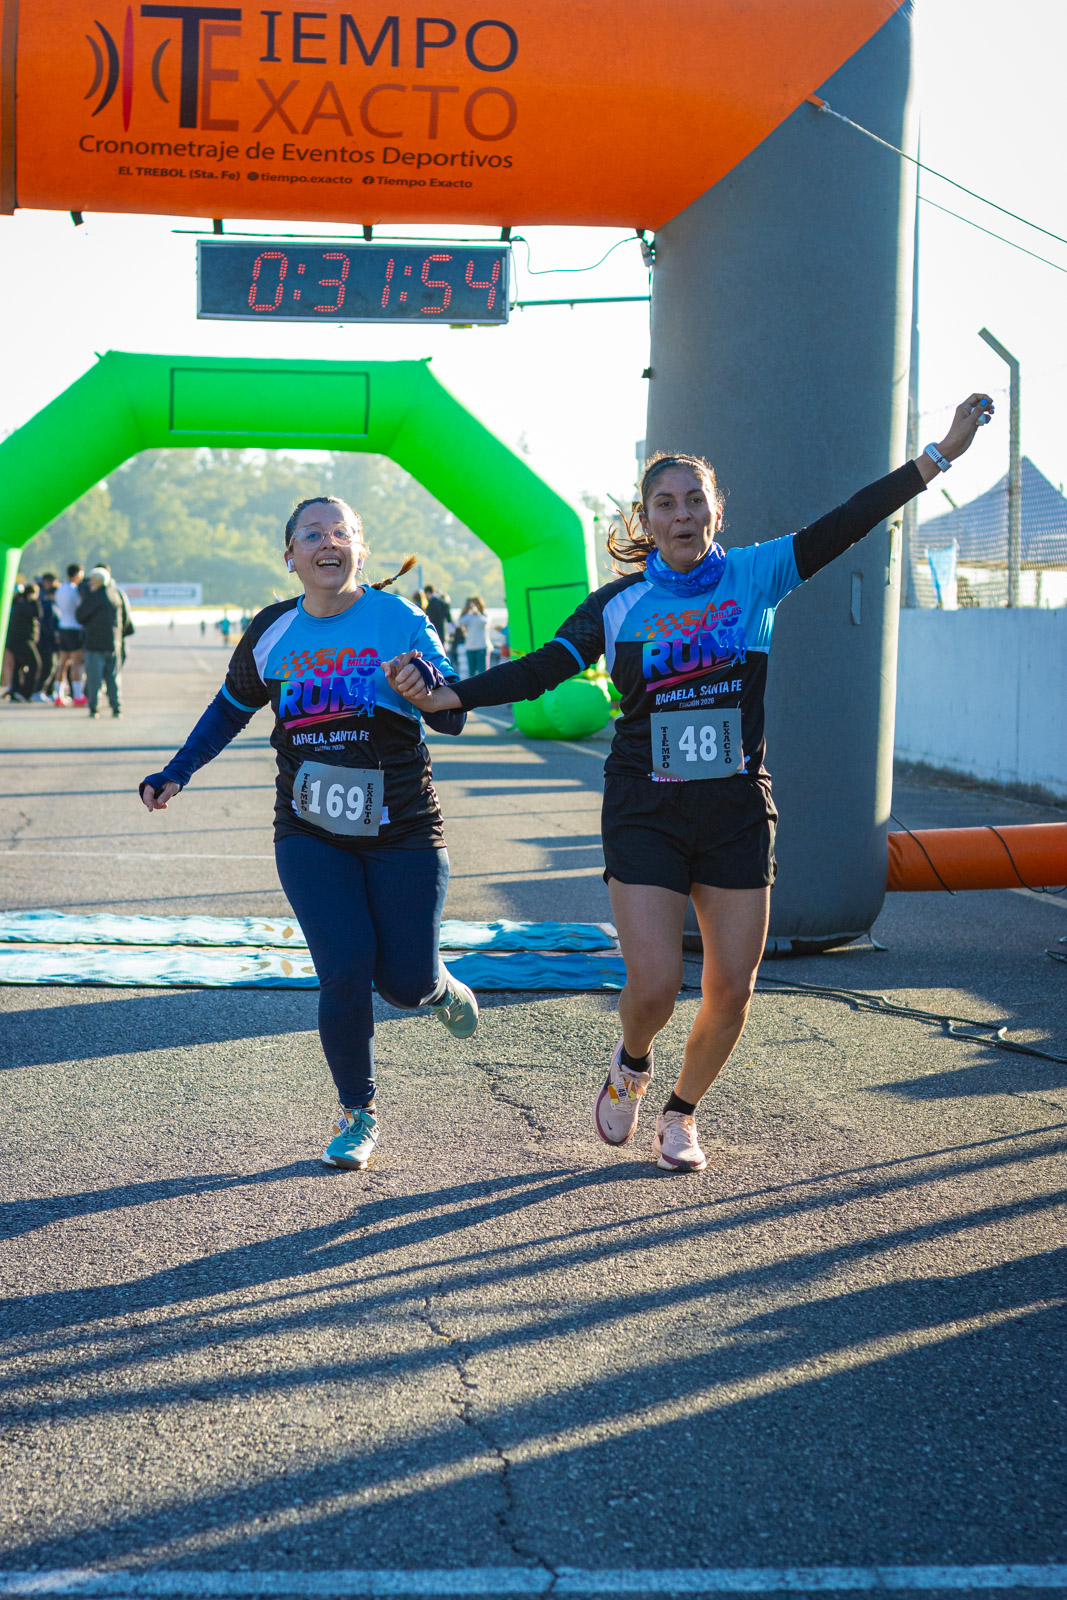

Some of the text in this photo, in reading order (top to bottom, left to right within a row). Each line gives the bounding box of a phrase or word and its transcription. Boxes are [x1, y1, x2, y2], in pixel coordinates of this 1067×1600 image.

[78, 134, 513, 169] Cronometraje de Eventos Deportivos
[118, 166, 240, 181] EL TREBOL (Sta. Fe)
[261, 173, 353, 185] tiempo.exacto
[377, 176, 473, 188] Tiempo Exacto
[247, 251, 501, 314] 0:31:54
[711, 607, 742, 621] MILLAS
[348, 658, 381, 667] MILLAS
[642, 629, 733, 679] RUN
[279, 677, 362, 718] RUN
[655, 679, 742, 706] RAFAELA, SANTA FE
[329, 730, 357, 743] SANTA
[359, 729, 369, 742] FE
[660, 726, 670, 769] TIEMPO
[678, 725, 717, 762] 48
[723, 721, 732, 764] EXACTO
[308, 780, 364, 821] 169
[363, 783, 374, 825] EXACTO
